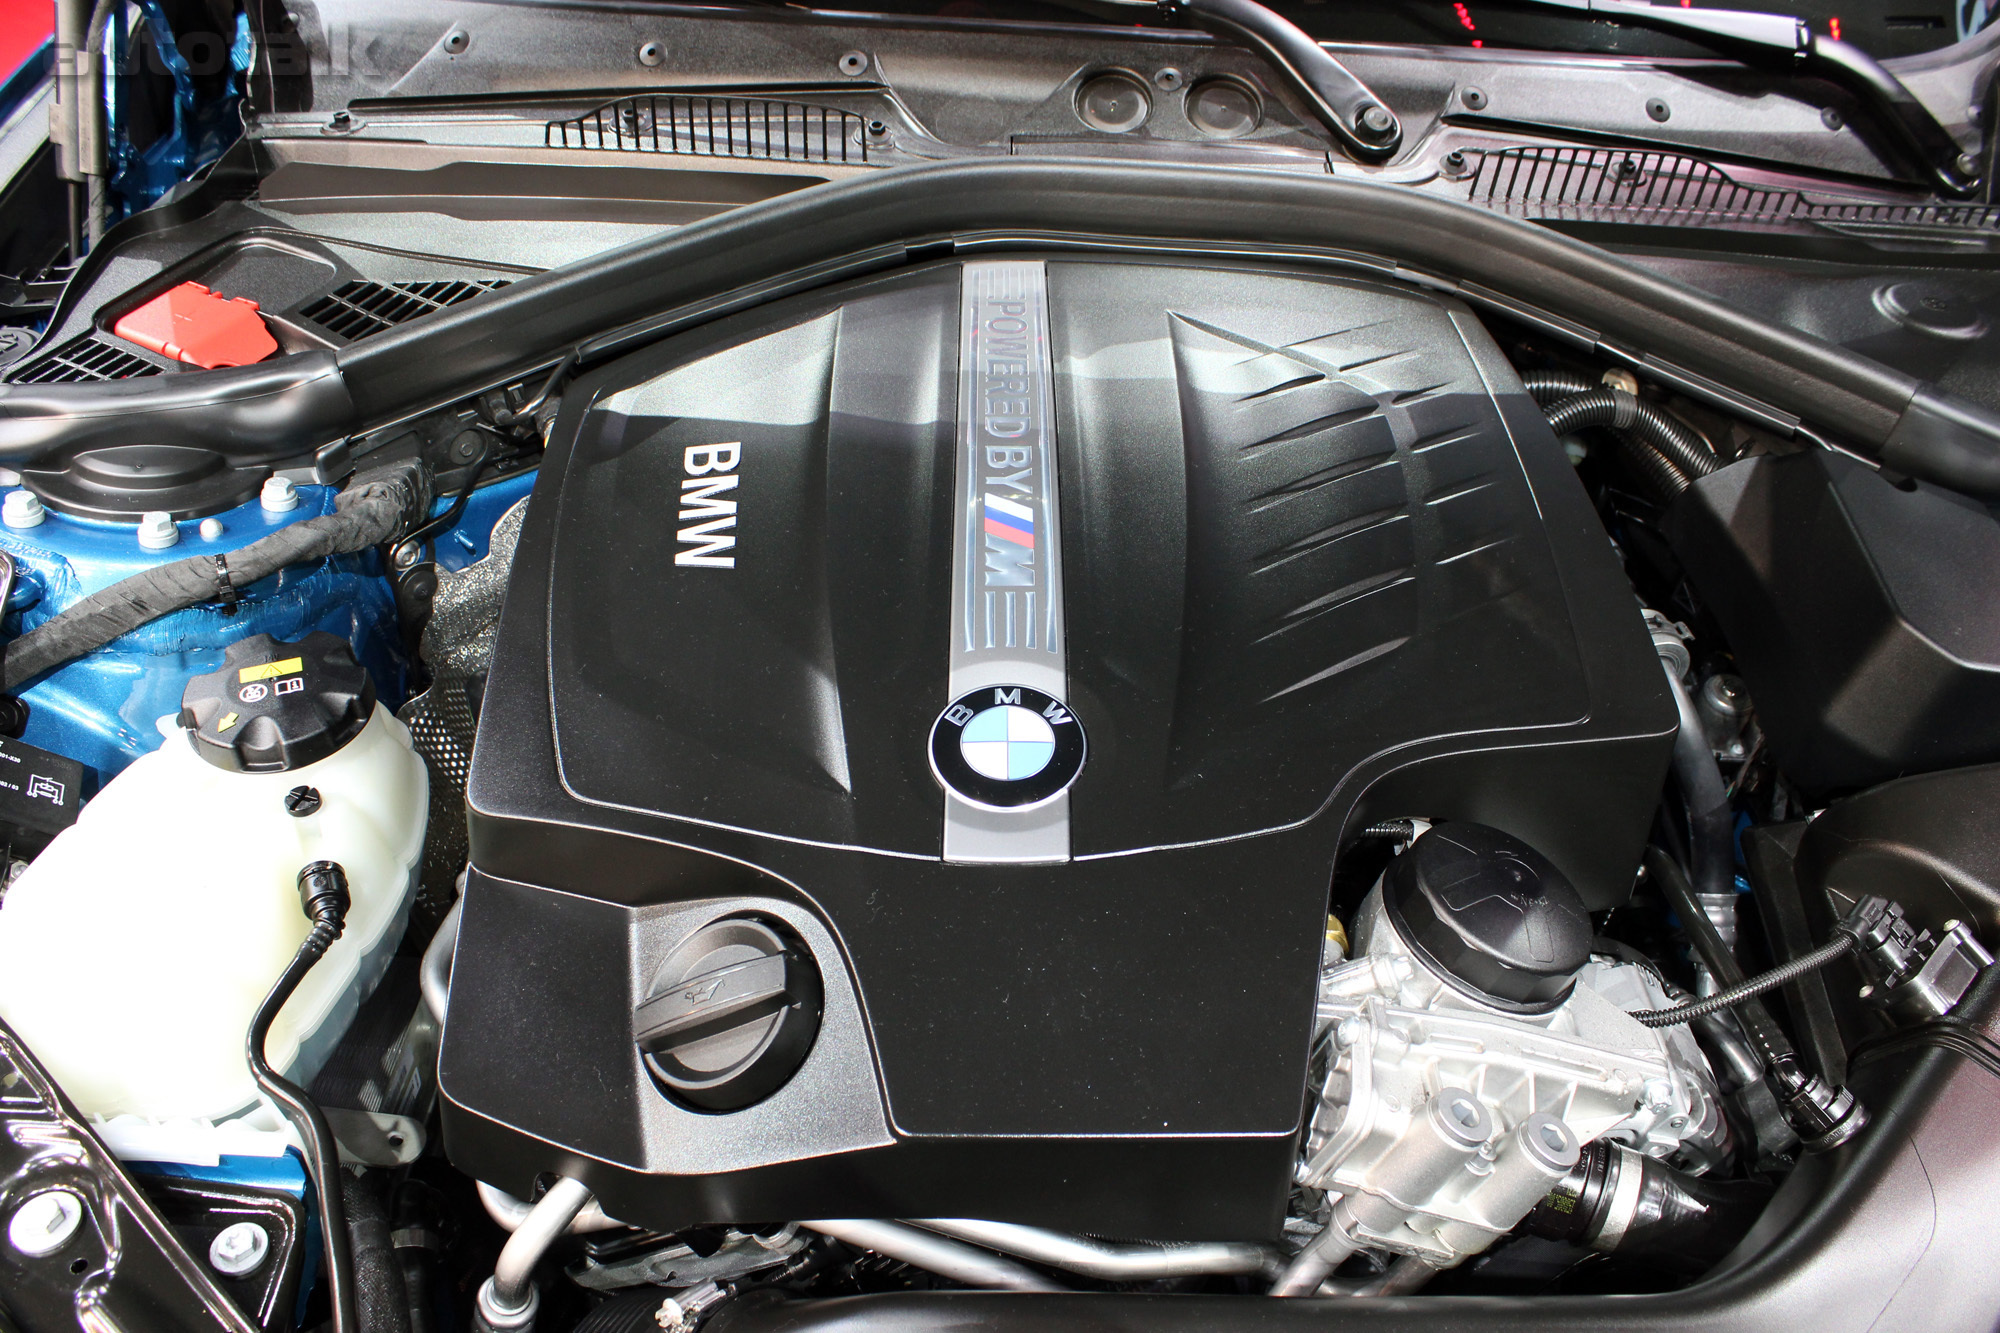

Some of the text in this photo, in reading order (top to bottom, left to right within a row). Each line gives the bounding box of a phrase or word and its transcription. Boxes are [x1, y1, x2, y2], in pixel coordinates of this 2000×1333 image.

[985, 300, 1031, 438] POWERED
[674, 441, 742, 569] BMW
[985, 445, 1033, 494] BY
[944, 687, 1073, 727] BMW
